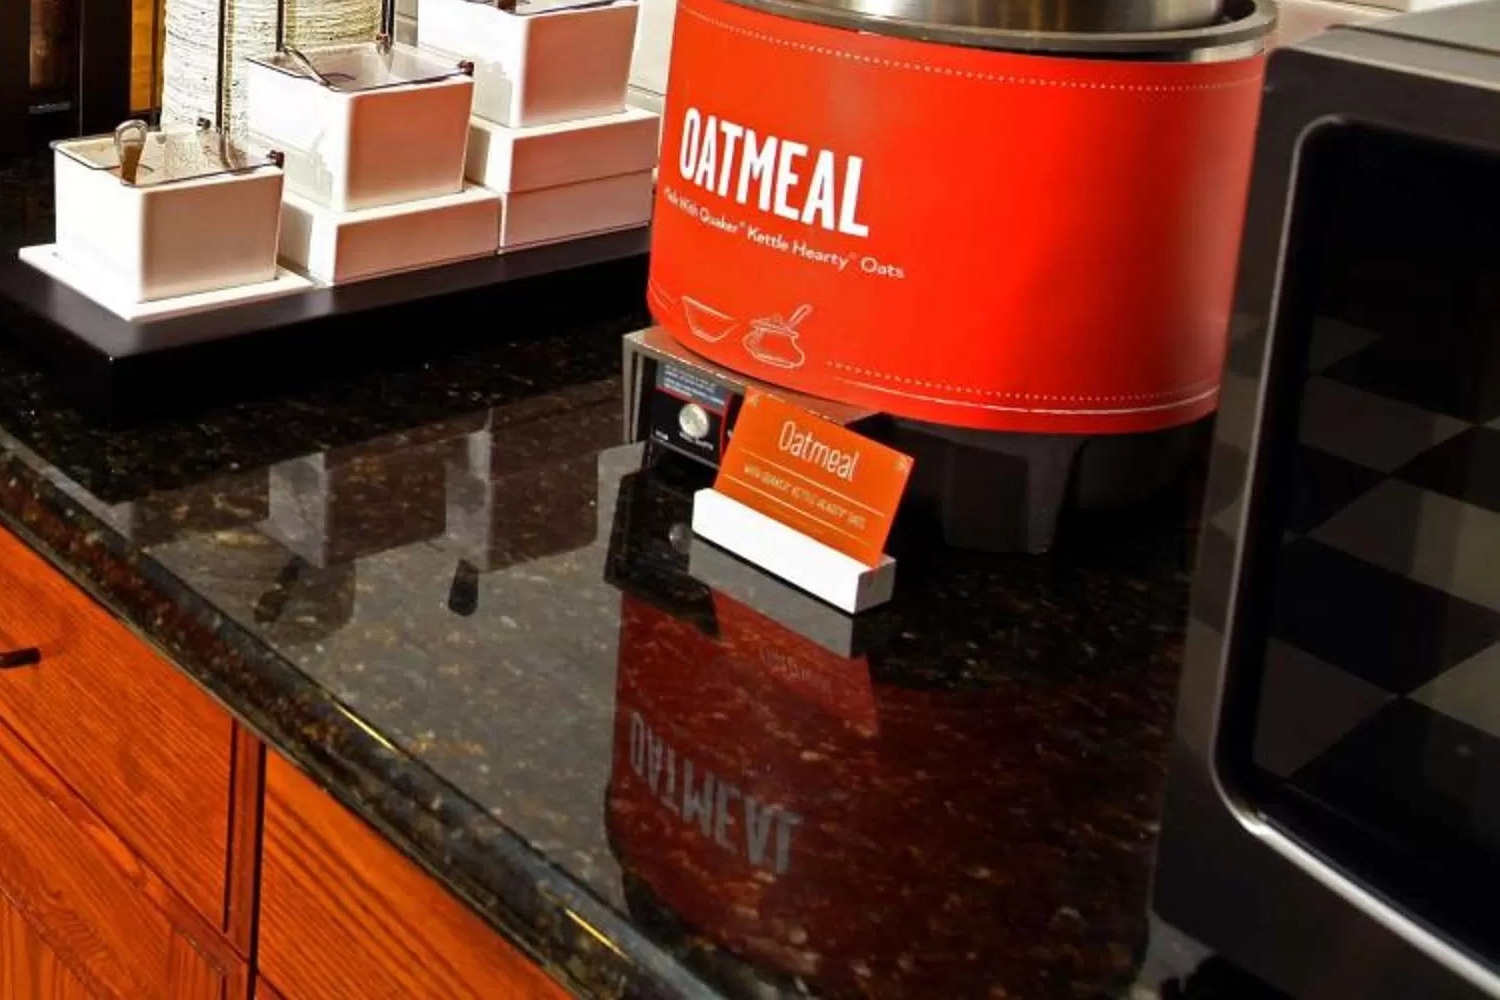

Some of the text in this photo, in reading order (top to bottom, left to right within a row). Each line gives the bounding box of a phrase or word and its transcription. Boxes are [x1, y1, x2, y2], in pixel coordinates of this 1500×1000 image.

[679, 107, 869, 238] OATMEAL
[747, 227, 789, 252] Kettle
[860, 256, 905, 279] Oats
[778, 420, 860, 482] Oatmeal
